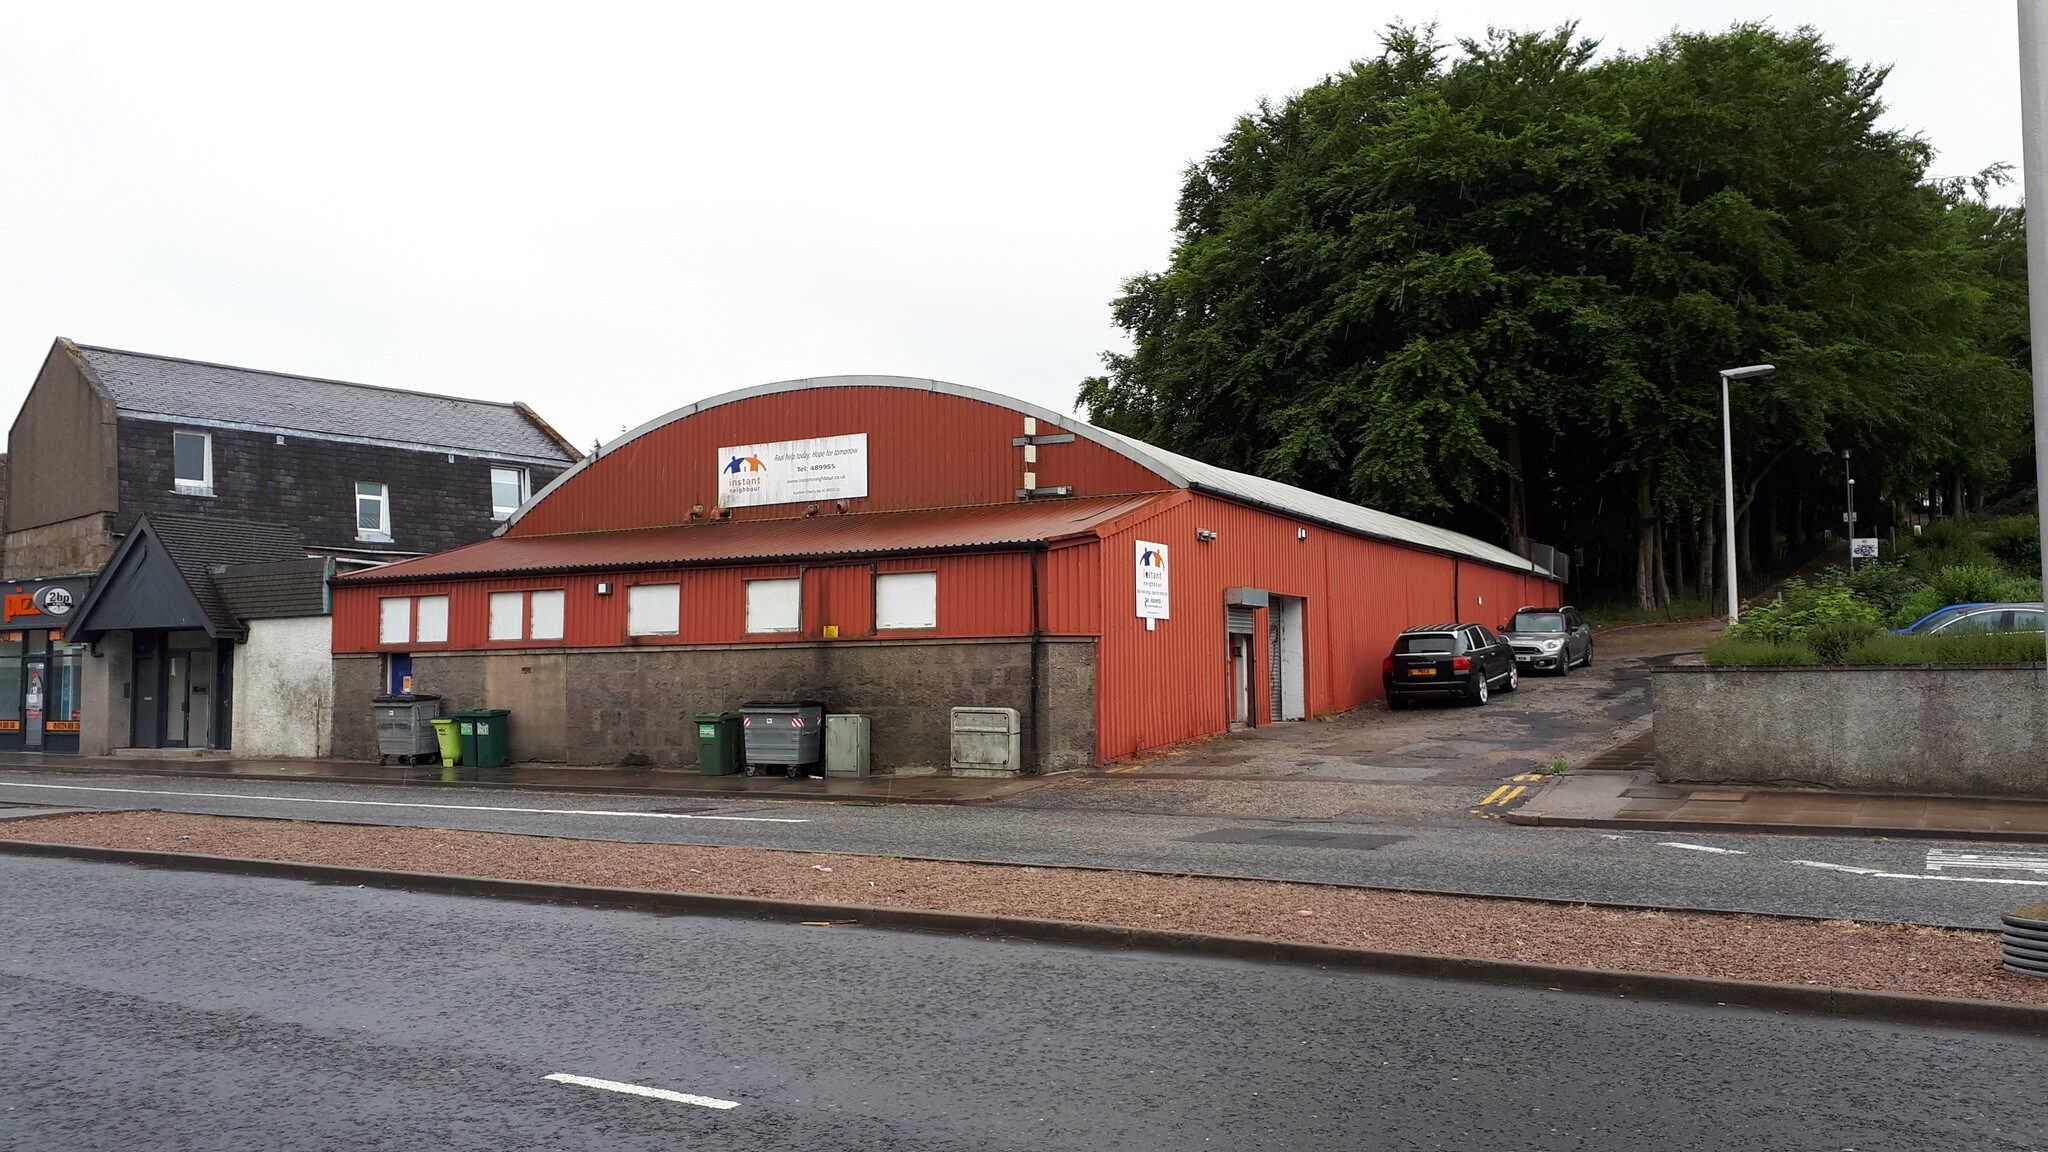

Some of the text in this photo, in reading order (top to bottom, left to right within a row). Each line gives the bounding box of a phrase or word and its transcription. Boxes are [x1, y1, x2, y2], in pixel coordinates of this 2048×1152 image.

[774, 454, 785, 462] Real
[785, 452, 796, 461] help
[812, 450, 825, 459] Hope
[825, 449, 834, 457] for
[729, 476, 760, 486] instant
[50, 592, 70, 603] 2bp
